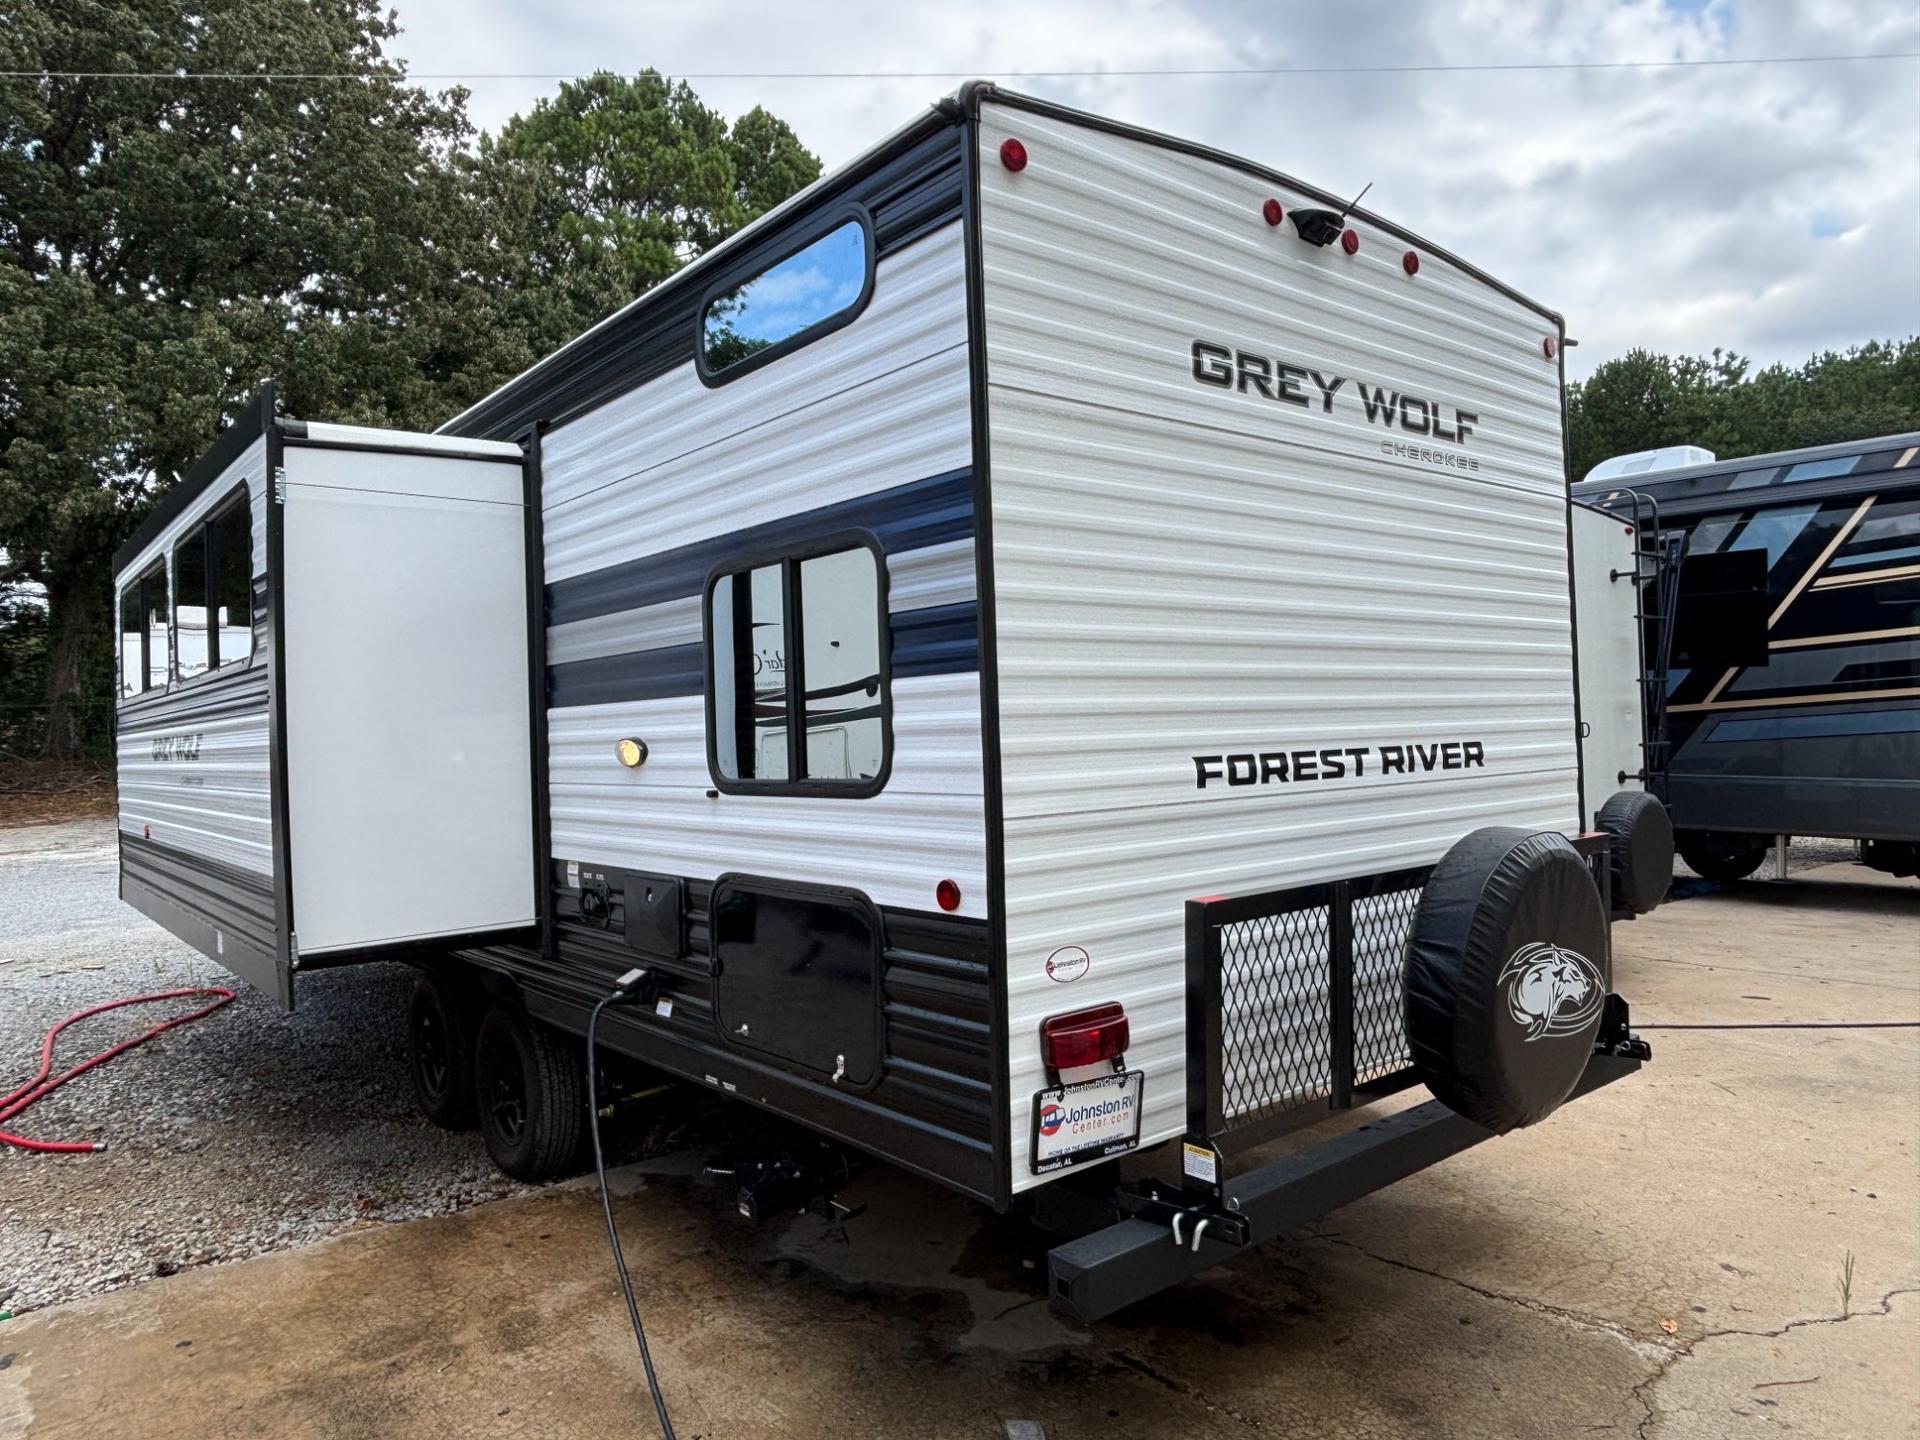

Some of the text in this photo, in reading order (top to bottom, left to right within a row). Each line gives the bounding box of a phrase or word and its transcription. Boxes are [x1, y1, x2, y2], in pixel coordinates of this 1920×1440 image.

[1191, 339, 1479, 445] GREY WOLF
[1381, 440, 1480, 471] CHEROKEE
[1191, 741, 1485, 789] FOREST RIVER
[1066, 1094, 1134, 1124] Johnston RV
[1072, 1111, 1129, 1134] Center.com
